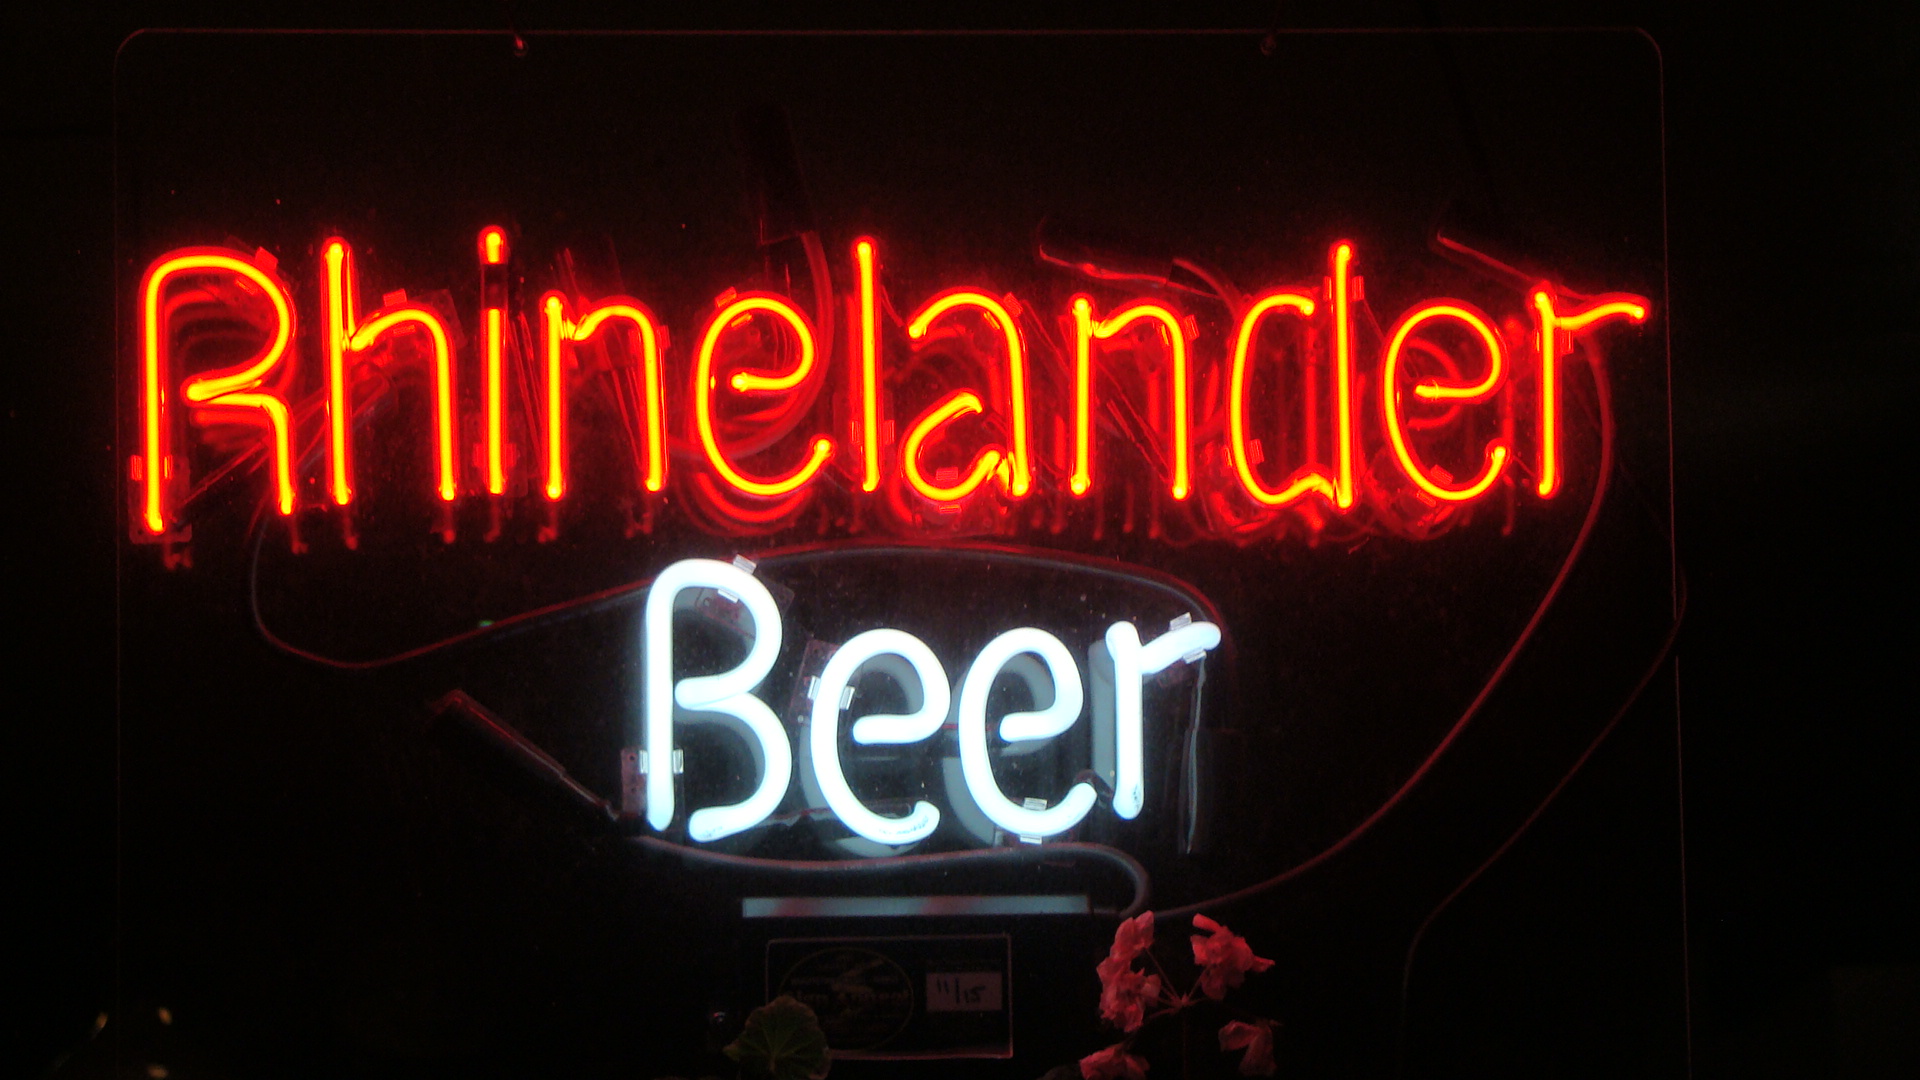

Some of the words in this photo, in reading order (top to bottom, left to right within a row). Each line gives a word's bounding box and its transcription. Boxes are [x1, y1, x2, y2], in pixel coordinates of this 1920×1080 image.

[137, 226, 1651, 532] Rhinelander
[643, 558, 1221, 844] Beer
[935, 976, 987, 1005] 11/15
